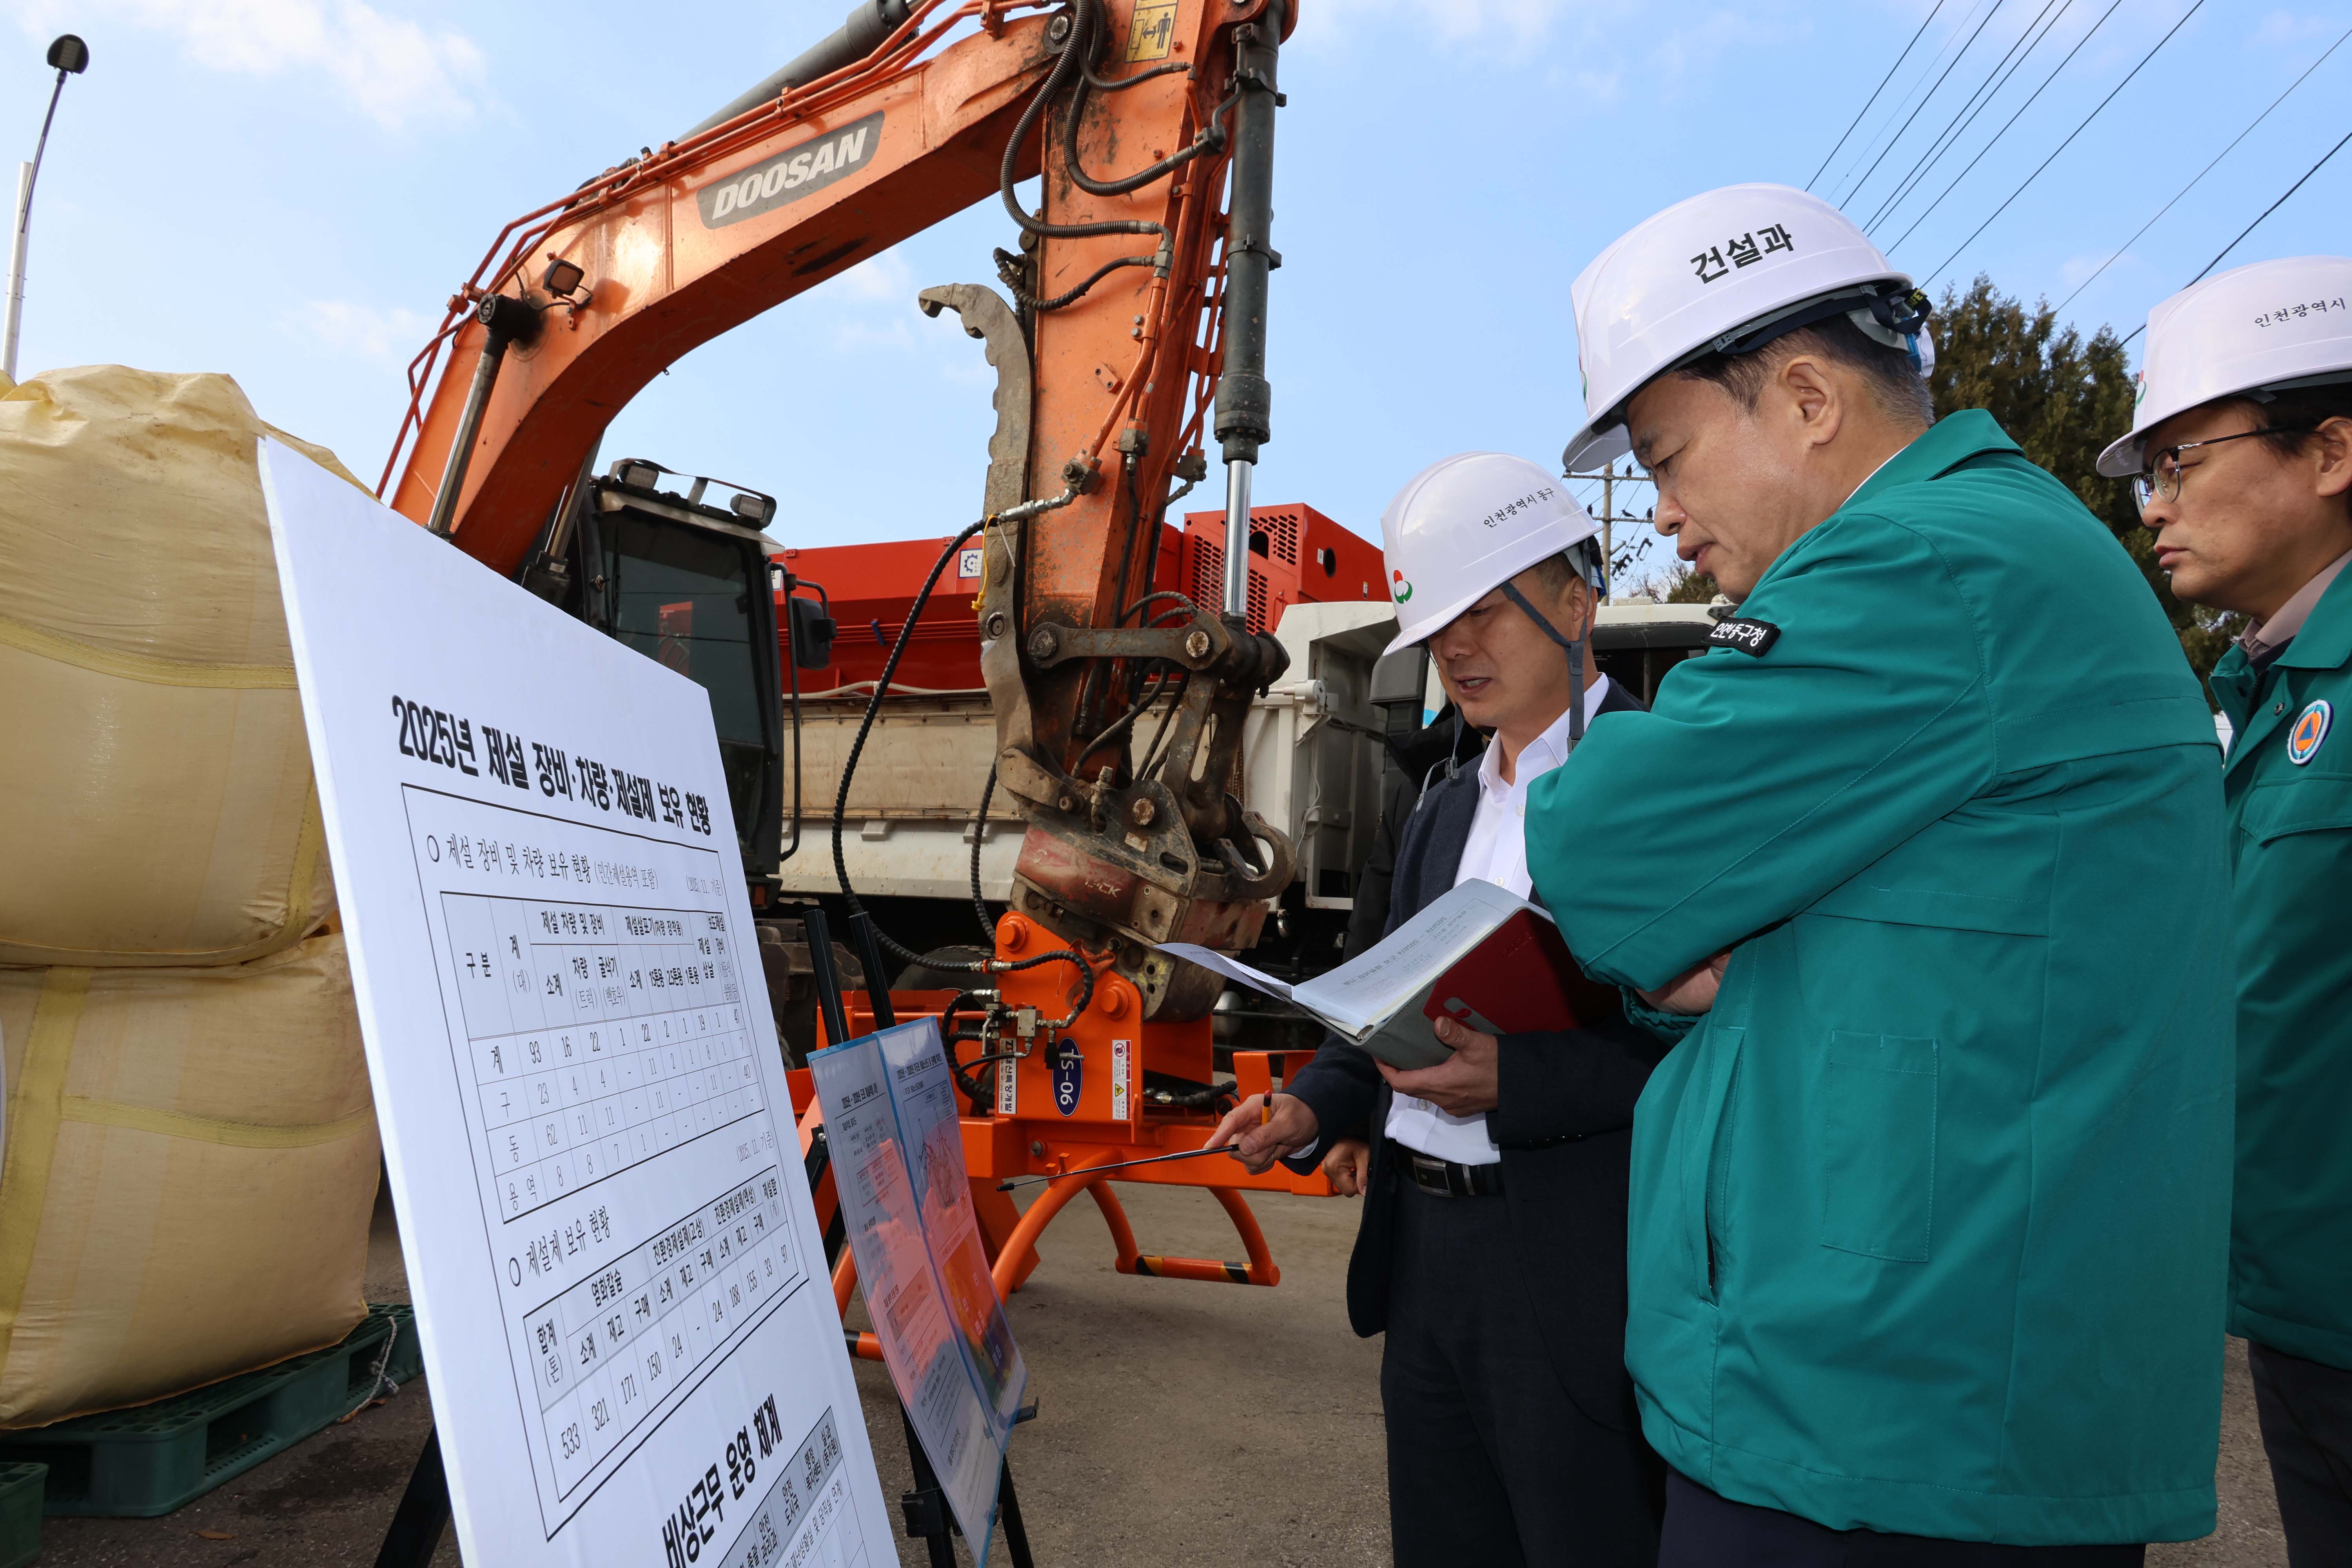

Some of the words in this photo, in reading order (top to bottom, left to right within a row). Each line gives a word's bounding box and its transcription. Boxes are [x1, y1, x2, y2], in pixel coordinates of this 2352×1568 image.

[713, 127, 867, 220] DOOSAN
[1690, 223, 1794, 284] 건설과
[2255, 298, 2345, 327] 인천광역시
[1484, 494, 1537, 528] 인천광역시
[1537, 488, 1555, 501] 동구
[1710, 623, 1767, 647] 인천동구청
[392, 695, 479, 777] 2025년
[481, 725, 530, 790] 제설
[657, 782, 684, 829] 보유
[685, 791, 711, 836] 현황
[446, 833, 474, 869] 제설
[477, 838, 502, 874] 장비
[505, 844, 520, 875] 및
[523, 846, 544, 878] 차량
[548, 851, 568, 881] 보유
[571, 853, 591, 884] 현황
[640, 867, 659, 890] 포함)
[541, 911, 559, 934] 제설
[561, 912, 577, 935] 차량
[579, 913, 588, 935] 및
[589, 913, 605, 935] 장비
[510, 935, 521, 960] 계
[698, 937, 711, 955] 제설
[715, 937, 726, 955] 장비
[572, 956, 588, 979] 차량
[598, 956, 619, 978] 굴삭기
[686, 967, 699, 985] 1톤용
[703, 960, 715, 979] 삽날
[513, 969, 531, 994] (대)
[546, 973, 563, 996] 소계
[630, 969, 643, 990] 소계
[575, 987, 598, 1010] (트럭)
[664, 1020, 670, 1037] 2
[683, 1017, 688, 1034] 1
[698, 1014, 705, 1031] 19
[716, 1012, 720, 1027] 1
[590, 1031, 601, 1052] 22
[619, 1027, 626, 1046] 1
[641, 1023, 651, 1042] 22
[740, 1037, 744, 1051] 7
[529, 1041, 541, 1064] 93
[562, 1036, 572, 1057] 16
[689, 1049, 693, 1064] 1
[706, 1045, 711, 1060] 8
[722, 1041, 726, 1056] 1
[491, 1045, 504, 1074] 계
[649, 1058, 657, 1075] 11
[670, 1053, 676, 1069] 2
[601, 1069, 606, 1087] 4
[710, 1074, 718, 1090] 11
[744, 1064, 751, 1079] 40
[538, 1083, 549, 1104] 23
[573, 1076, 578, 1095] 4
[501, 1092, 510, 1118] 구
[655, 1091, 664, 1109] 11
[578, 1114, 588, 1135] 11
[605, 1106, 615, 1125] 11
[546, 1123, 558, 1146] 62
[641, 1134, 646, 1151] 1
[509, 1136, 519, 1162] 동
[614, 1143, 620, 1162] 7
[586, 1154, 593, 1174] 8
[557, 1166, 564, 1187] 8
[762, 1177, 777, 1200] 제설함
[753, 1212, 764, 1234] 구매
[526, 1230, 563, 1278] 제설제
[565, 1218, 586, 1256] 보유
[589, 1205, 610, 1243] 현황
[720, 1236, 731, 1259] 소계
[736, 1226, 747, 1246] 재고
[700, 1248, 714, 1274] 구매
[780, 1244, 788, 1263] 97
[680, 1264, 693, 1288] 재고
[764, 1257, 772, 1277] 33
[591, 1268, 623, 1308] 염화칼슘
[660, 1276, 673, 1304] 소계
[746, 1270, 757, 1292] 155
[729, 1284, 740, 1308] 188
[634, 1292, 651, 1324] 구매
[712, 1299, 723, 1323] 24
[537, 1318, 557, 1355] 합계
[607, 1314, 624, 1343] 재고
[580, 1332, 597, 1365] 소계
[672, 1333, 683, 1359] 24
[545, 1352, 563, 1388] (톤)
[647, 1351, 661, 1381] 150
[621, 1373, 637, 1405] 171
[592, 1397, 610, 1431] 321
[561, 1422, 580, 1459] 533
[805, 1445, 815, 1470] 행정
[662, 1462, 724, 1568] 비상근무
[726, 1425, 755, 1501] 운영
[753, 1393, 782, 1460] 체계
[782, 1477, 793, 1504] 안전
[785, 1494, 800, 1526] 도시국
[813, 1515, 820, 1535] 및
[818, 1494, 833, 1525] 당직실
[759, 1510, 771, 1541] 안전
[762, 1528, 778, 1566] 관리과
